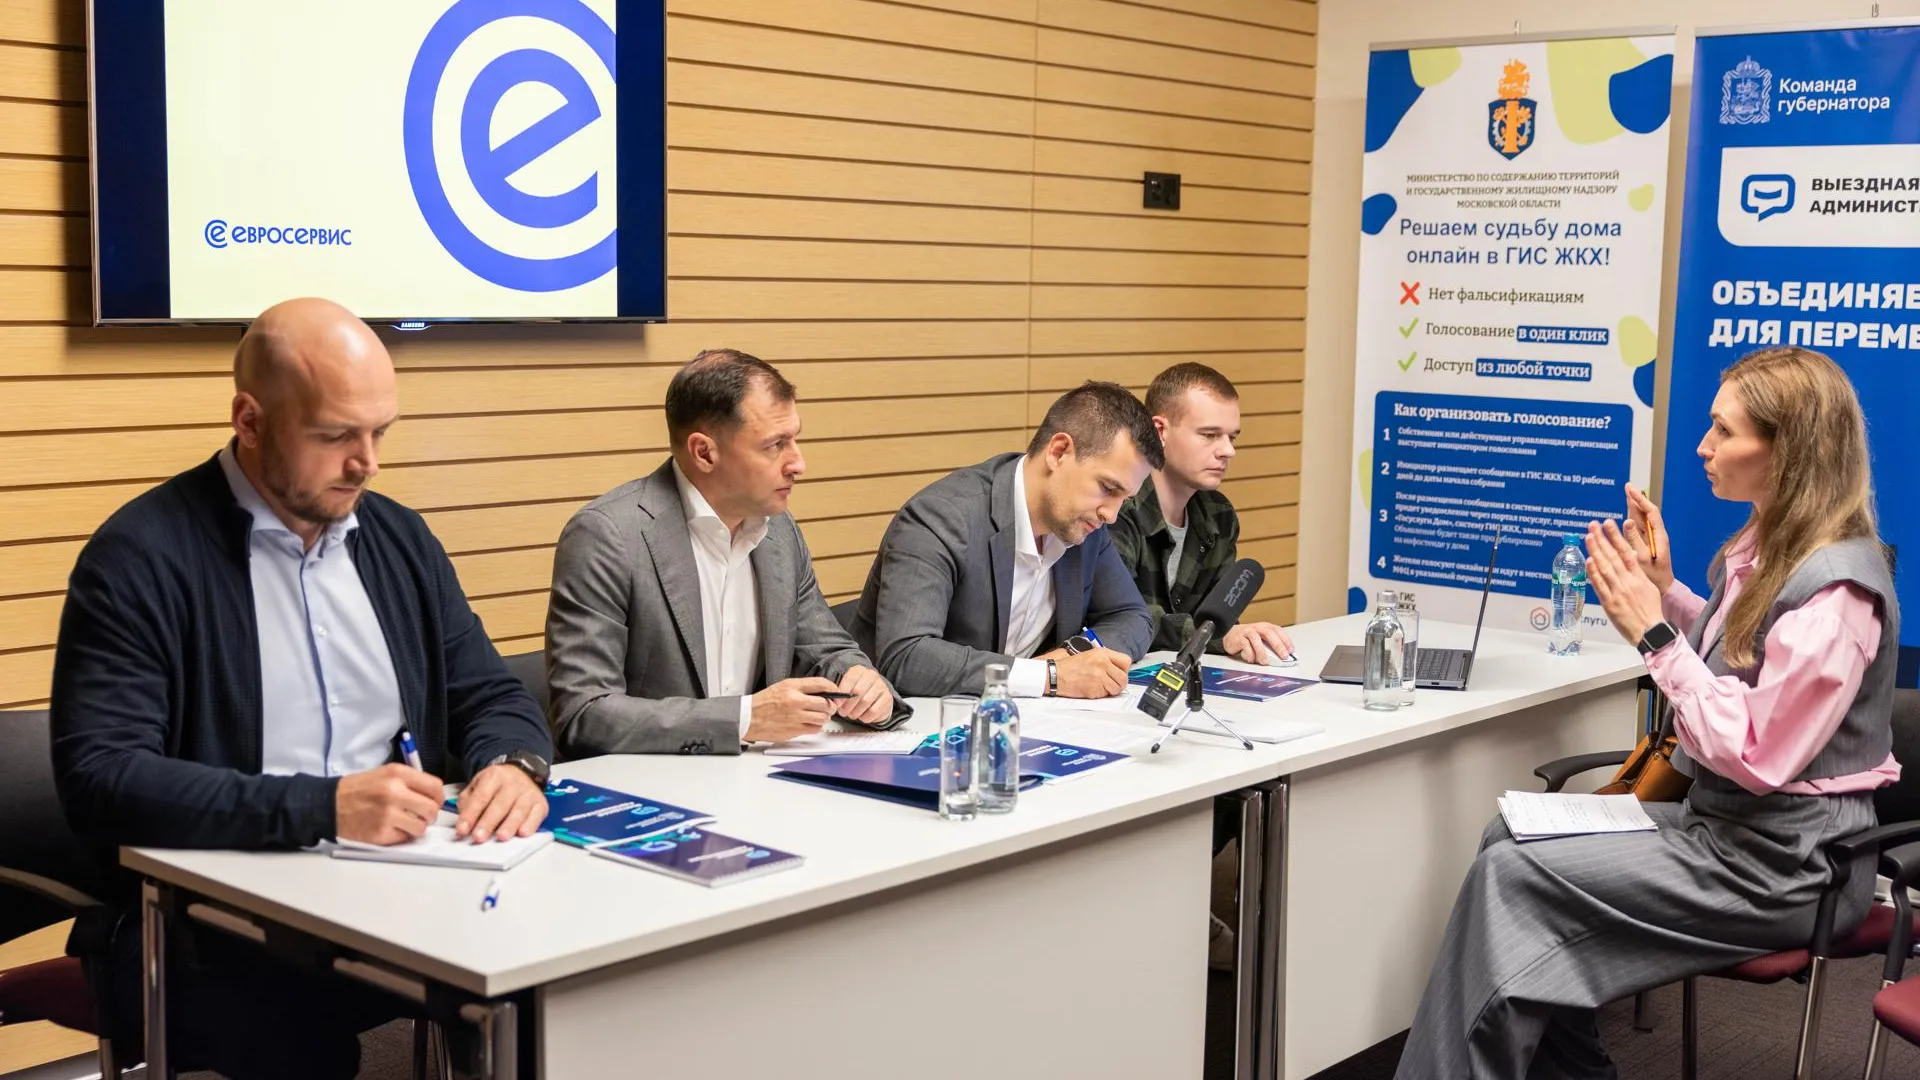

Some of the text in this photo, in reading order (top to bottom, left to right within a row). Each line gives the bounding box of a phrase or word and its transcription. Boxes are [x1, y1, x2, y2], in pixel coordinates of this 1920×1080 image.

[1779, 77, 1857, 94] Команда
[1777, 95, 1890, 115] губернатора
[1407, 170, 1621, 183] МИНИСТЕРСТВО ПО СОДЕРЖАНИЮ ТЕРРИТОРИЙ
[1406, 185, 1618, 197] И ГОСУДАРСТВЕННОМУ ЖИЛИЩНОМУ НАДЗОРУ
[1811, 177, 1920, 193] ВЫЕЗДНАЯ
[1456, 198, 1562, 209] МОСКОВСКОЙ ОБЛАСТИ
[1809, 199, 1920, 215] АДМИНИСТ
[1400, 218, 1621, 241] Решаем судьбу дома
[1407, 247, 1610, 265] онлайн в ГИС ЖКХ!
[1429, 287, 1584, 305] Нет фальсификациям
[1425, 323, 1608, 344] Голосование в один клик
[1709, 319, 1781, 347] ДЛЯ
[1423, 357, 1590, 378] Доступ из любой точки
[1394, 403, 1611, 428] Как организовать голосование?
[1383, 427, 1391, 441] 1
[1381, 461, 1390, 475] 2
[1527, 471, 1542, 479] ГИС
[1543, 473, 1561, 481] ЖКХ
[1582, 476, 1614, 485] рабочих
[1380, 509, 1388, 522] 3
[1377, 556, 1386, 568] 4
[1224, 569, 1254, 607] ZOOM
[1399, 592, 1415, 602] ГИС
